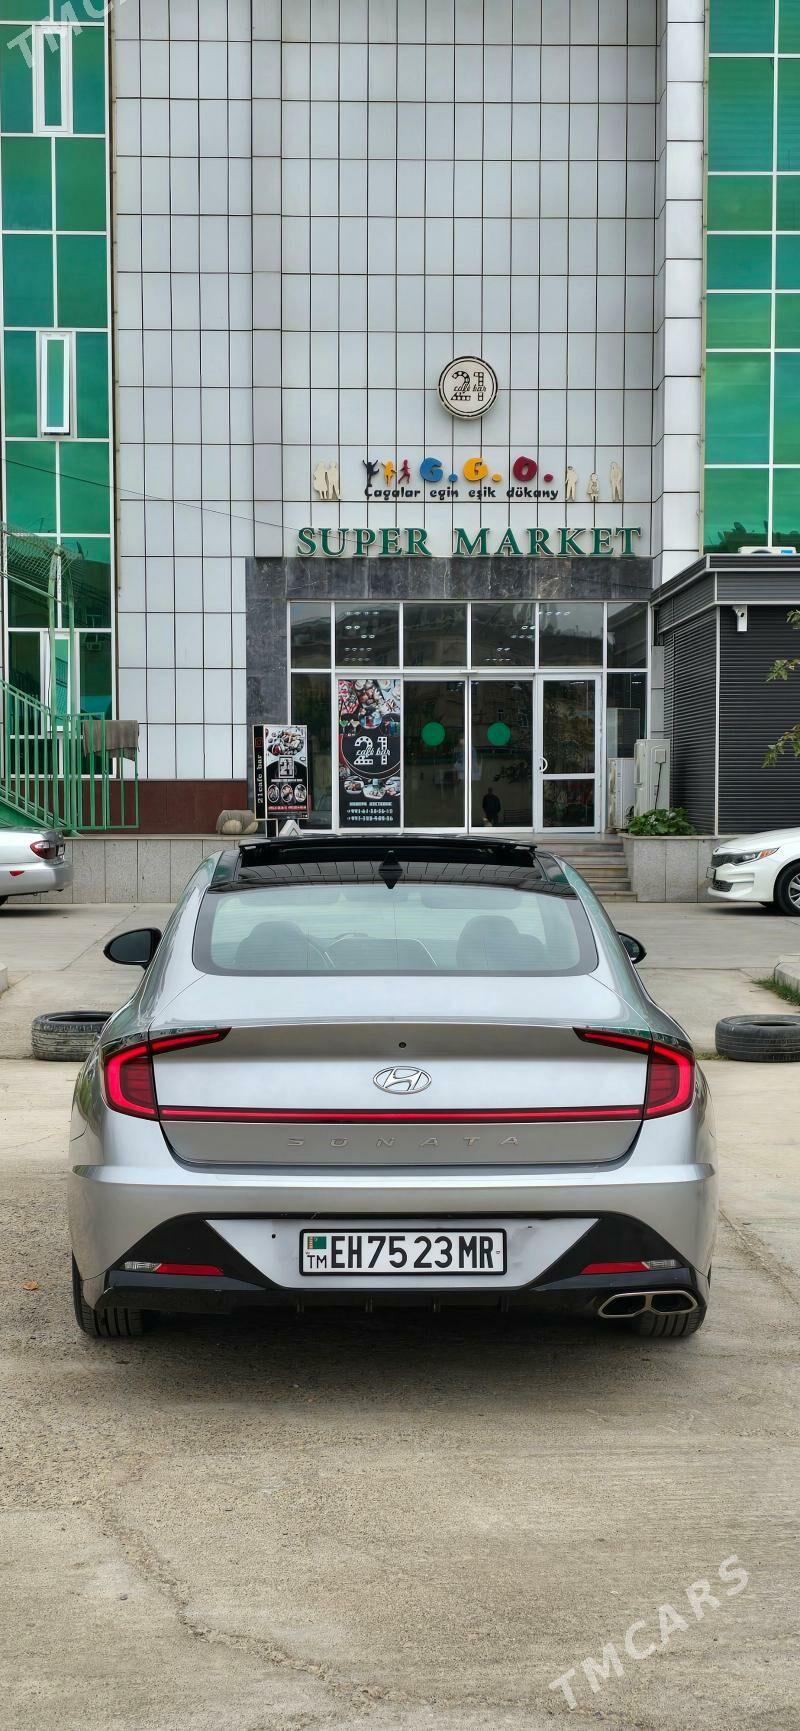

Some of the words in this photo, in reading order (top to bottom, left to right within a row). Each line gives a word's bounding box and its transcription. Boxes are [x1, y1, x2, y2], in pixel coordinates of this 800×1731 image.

[451, 370, 485, 401] 21
[506, 486, 559, 500] dükany
[296, 527, 433, 557] SUPER
[452, 527, 642, 557] MARKET
[353, 735, 388, 765] 21
[287, 1136, 520, 1147] SONATA
[307, 1255, 327, 1269] TM
